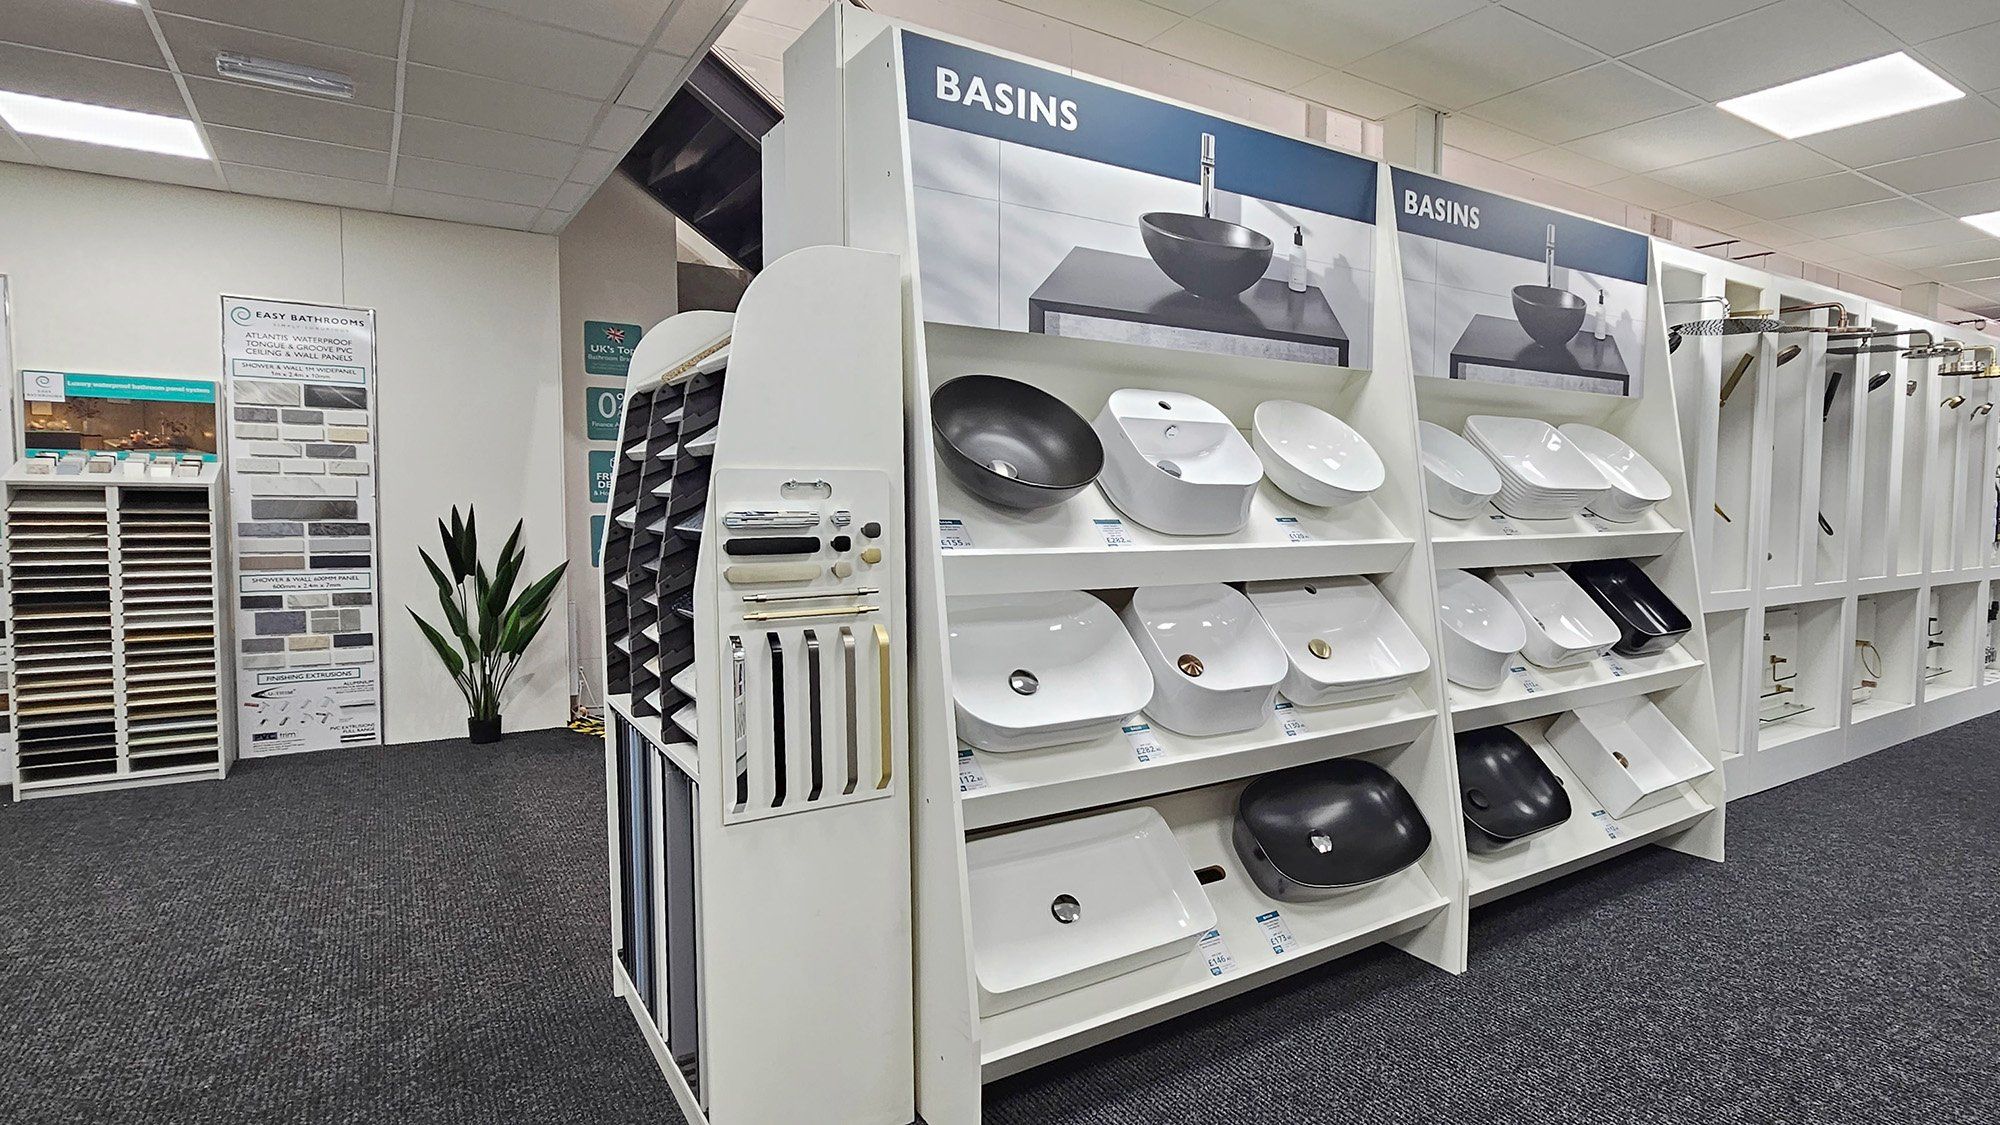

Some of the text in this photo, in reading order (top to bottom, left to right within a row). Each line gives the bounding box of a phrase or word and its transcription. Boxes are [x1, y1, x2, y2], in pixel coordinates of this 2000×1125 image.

[936, 65, 1078, 132] BASINS
[1404, 189, 1480, 230] BASINS
[256, 311, 365, 327] EASY BATHROOMS
[245, 332, 352, 346] ATLANTIS WATERPROOF
[246, 340, 285, 350] TONGUE
[296, 344, 334, 353] GROOVE
[590, 344, 615, 354] UK's
[245, 348, 282, 357] CEILING
[294, 352, 319, 360] WALL
[321, 354, 353, 362] PANELS
[242, 362, 274, 370] SHOWER
[266, 671, 353, 681] FINISHING EXTRUSIONS
